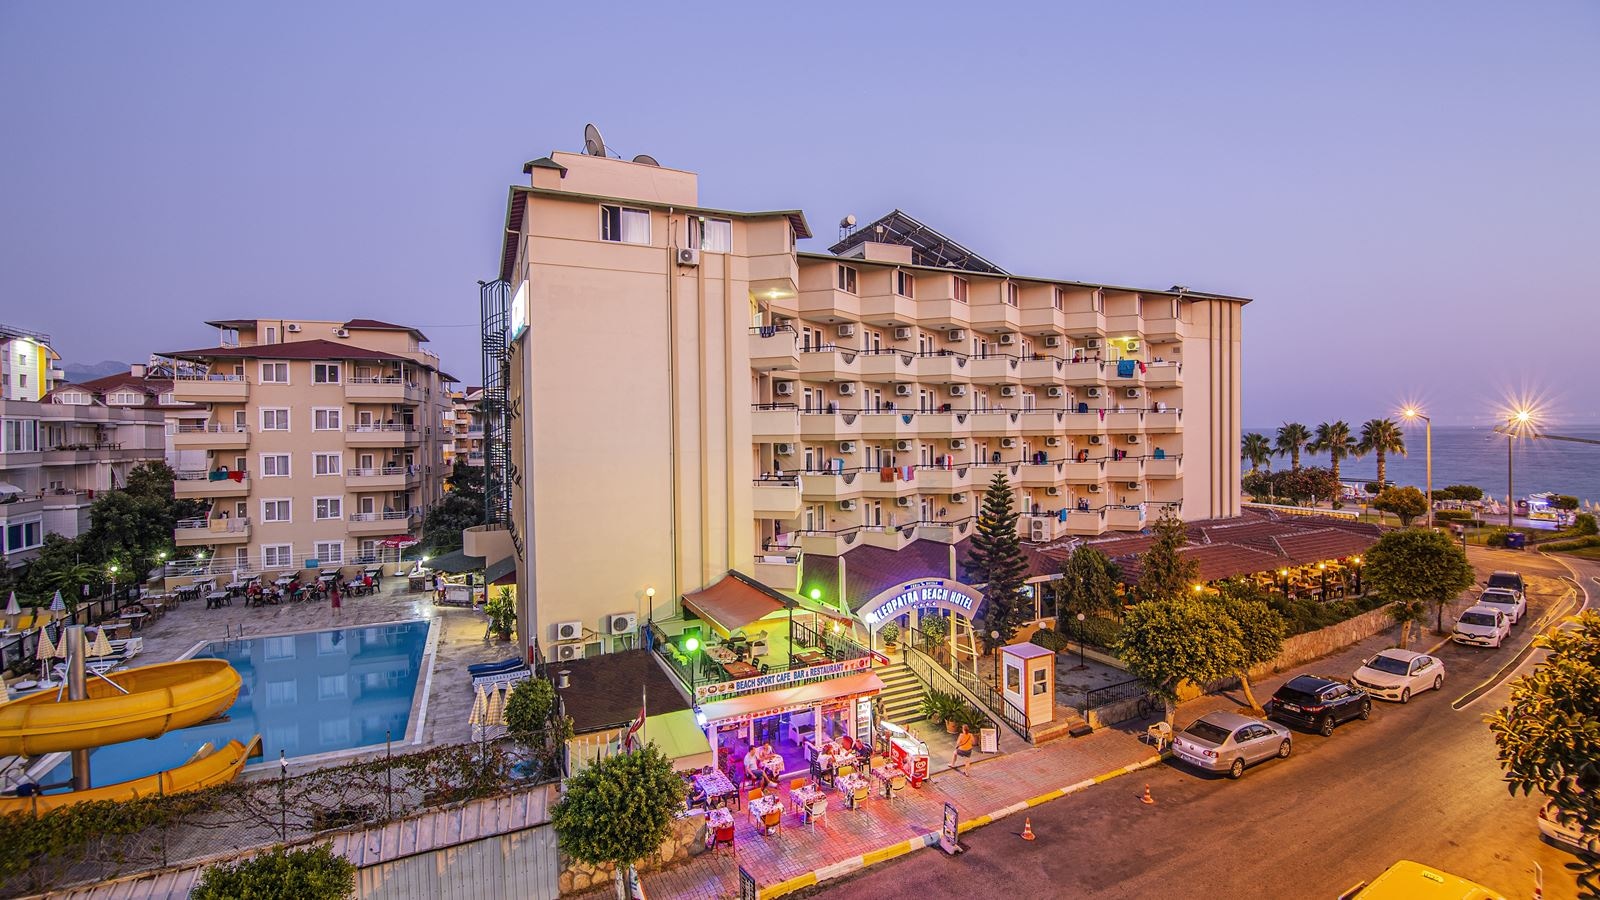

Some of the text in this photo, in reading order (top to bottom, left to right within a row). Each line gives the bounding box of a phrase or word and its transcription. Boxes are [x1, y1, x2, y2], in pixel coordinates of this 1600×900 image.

[921, 588, 948, 601] BEACH
[949, 591, 973, 610] HOTEL
[736, 678, 756, 690] BEACH
[757, 674, 776, 686] SPORT
[776, 672, 791, 683] CAFE
[793, 669, 805, 680] BAR
[809, 663, 844, 677] RESTAURANT
